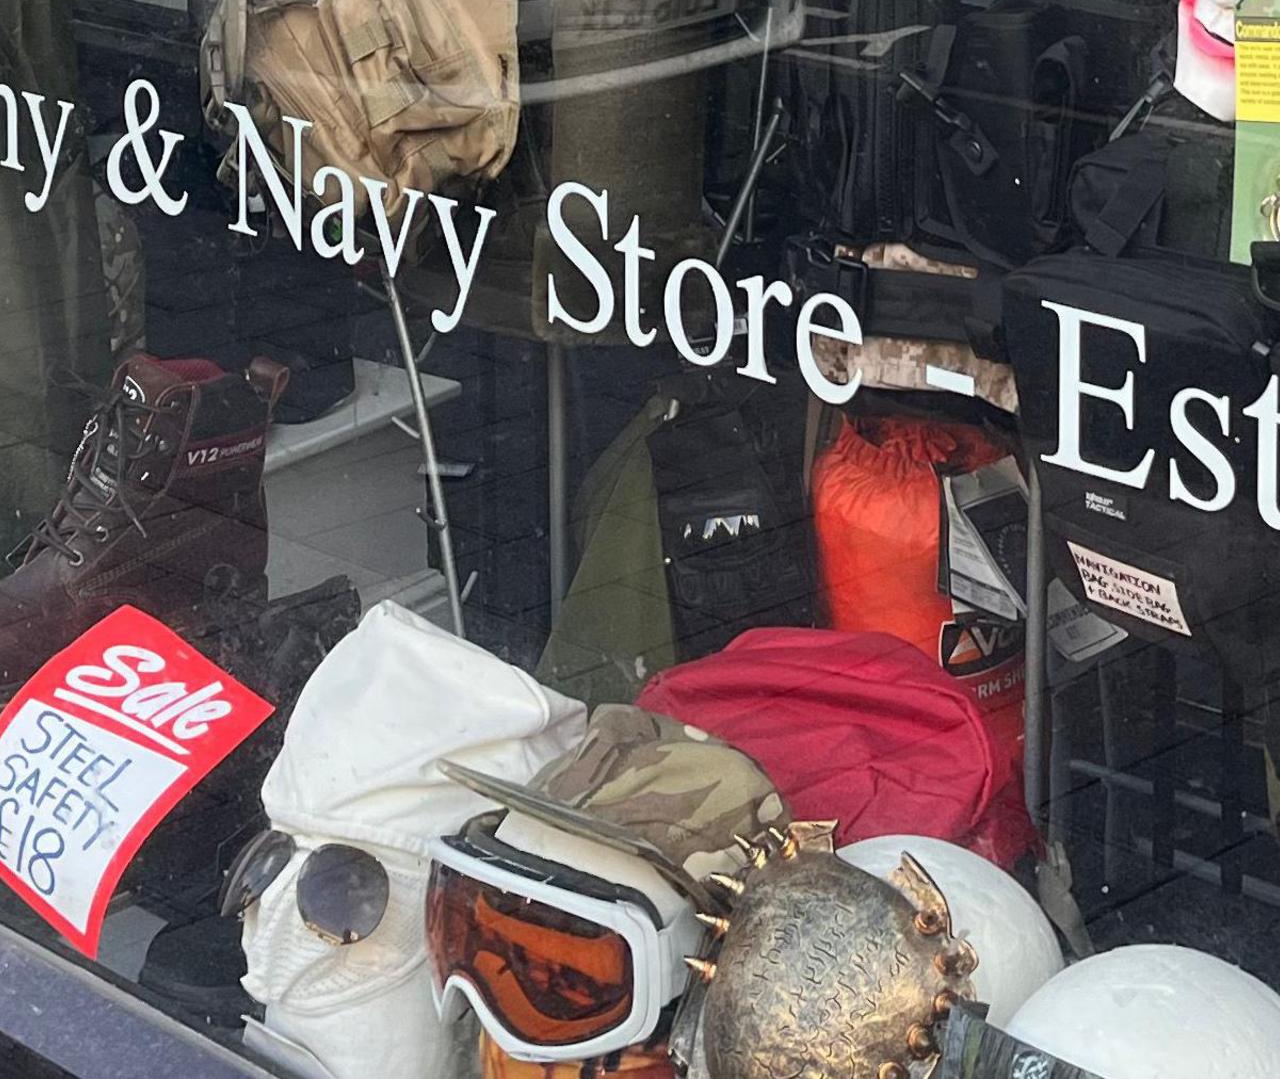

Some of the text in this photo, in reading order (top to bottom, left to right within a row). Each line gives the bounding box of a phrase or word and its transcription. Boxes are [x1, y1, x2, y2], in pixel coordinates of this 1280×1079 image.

[106, 78, 189, 217] &
[223, 101, 498, 334] Navy
[546, 181, 865, 406] Store
[925, 363, 976, 398] -
[187, 447, 220, 466] V12
[1084, 500, 1127, 520] TACTICAL
[62, 644, 233, 742] Sale
[19, 709, 138, 814] STEEL
